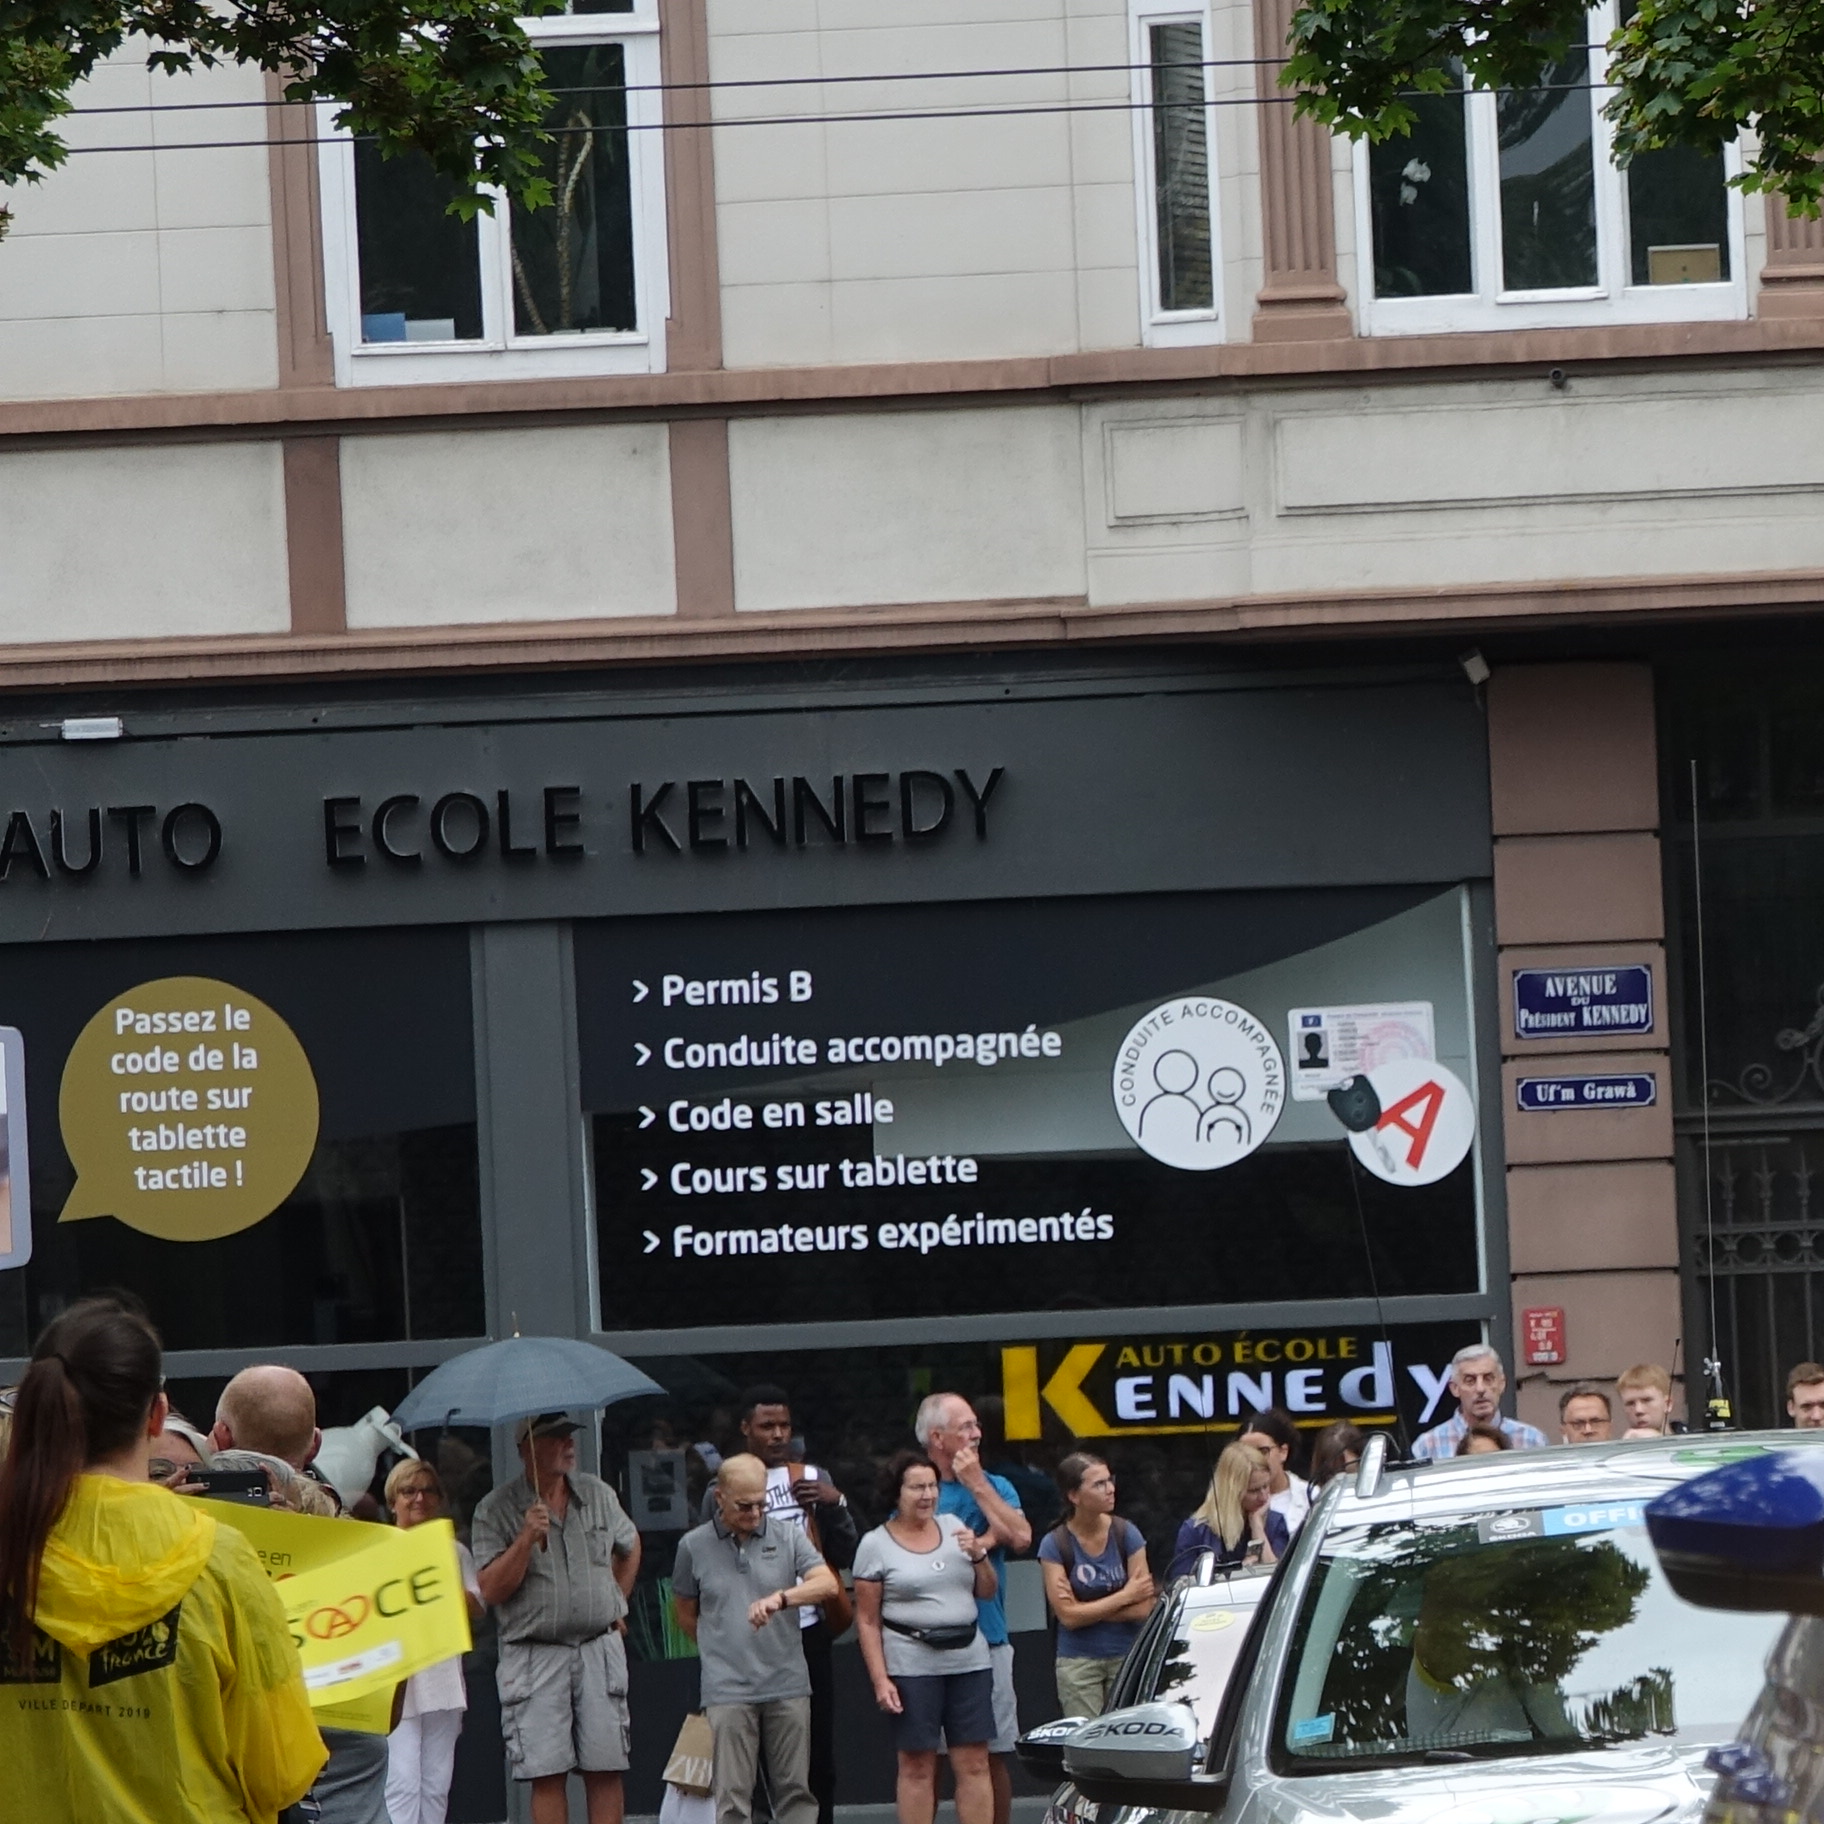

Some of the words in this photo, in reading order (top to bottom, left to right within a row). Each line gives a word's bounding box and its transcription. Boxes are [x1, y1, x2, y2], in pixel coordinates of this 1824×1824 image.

[0, 803, 223, 880] AUTO
[322, 786, 586, 868] ECOLE
[629, 766, 1006, 854] KENNEDY
[662, 971, 779, 1006] Permis
[789, 970, 813, 1001] B
[1545, 974, 1617, 998] AVENUE
[1571, 996, 1591, 1007] DU
[114, 1008, 217, 1035] Passez
[224, 1004, 251, 1032] le
[1582, 1003, 1648, 1027] KENNEDY
[110, 1046, 180, 1075] code
[188, 1044, 226, 1072] de
[232, 1043, 258, 1070] la
[663, 1033, 817, 1069] Conduite
[827, 1024, 1062, 1066] accompagnée
[1119, 1009, 1174, 1108] CONDUITE
[1180, 1002, 1281, 1116] ACCOMPAGNÉE
[119, 1084, 198, 1112] route
[206, 1085, 253, 1109] sur
[668, 1098, 754, 1132] Code
[762, 1101, 806, 1128] en
[815, 1093, 894, 1126] salle
[128, 1122, 247, 1152] tablette
[1375, 1079, 1447, 1172] A
[133, 1161, 227, 1192] tactile
[234, 1160, 244, 1188] !
[670, 1162, 768, 1195] Cours
[776, 1163, 829, 1192] sur
[838, 1154, 978, 1189] tablette
[672, 1221, 869, 1258] Formateurs
[877, 1207, 1115, 1255] expérimentés
[1116, 1342, 1222, 1369] AUTO
[1233, 1330, 1359, 1364] ÉCOLE
[270, 1552, 292, 1567] en
[18, 1699, 57, 1712] VILLE
